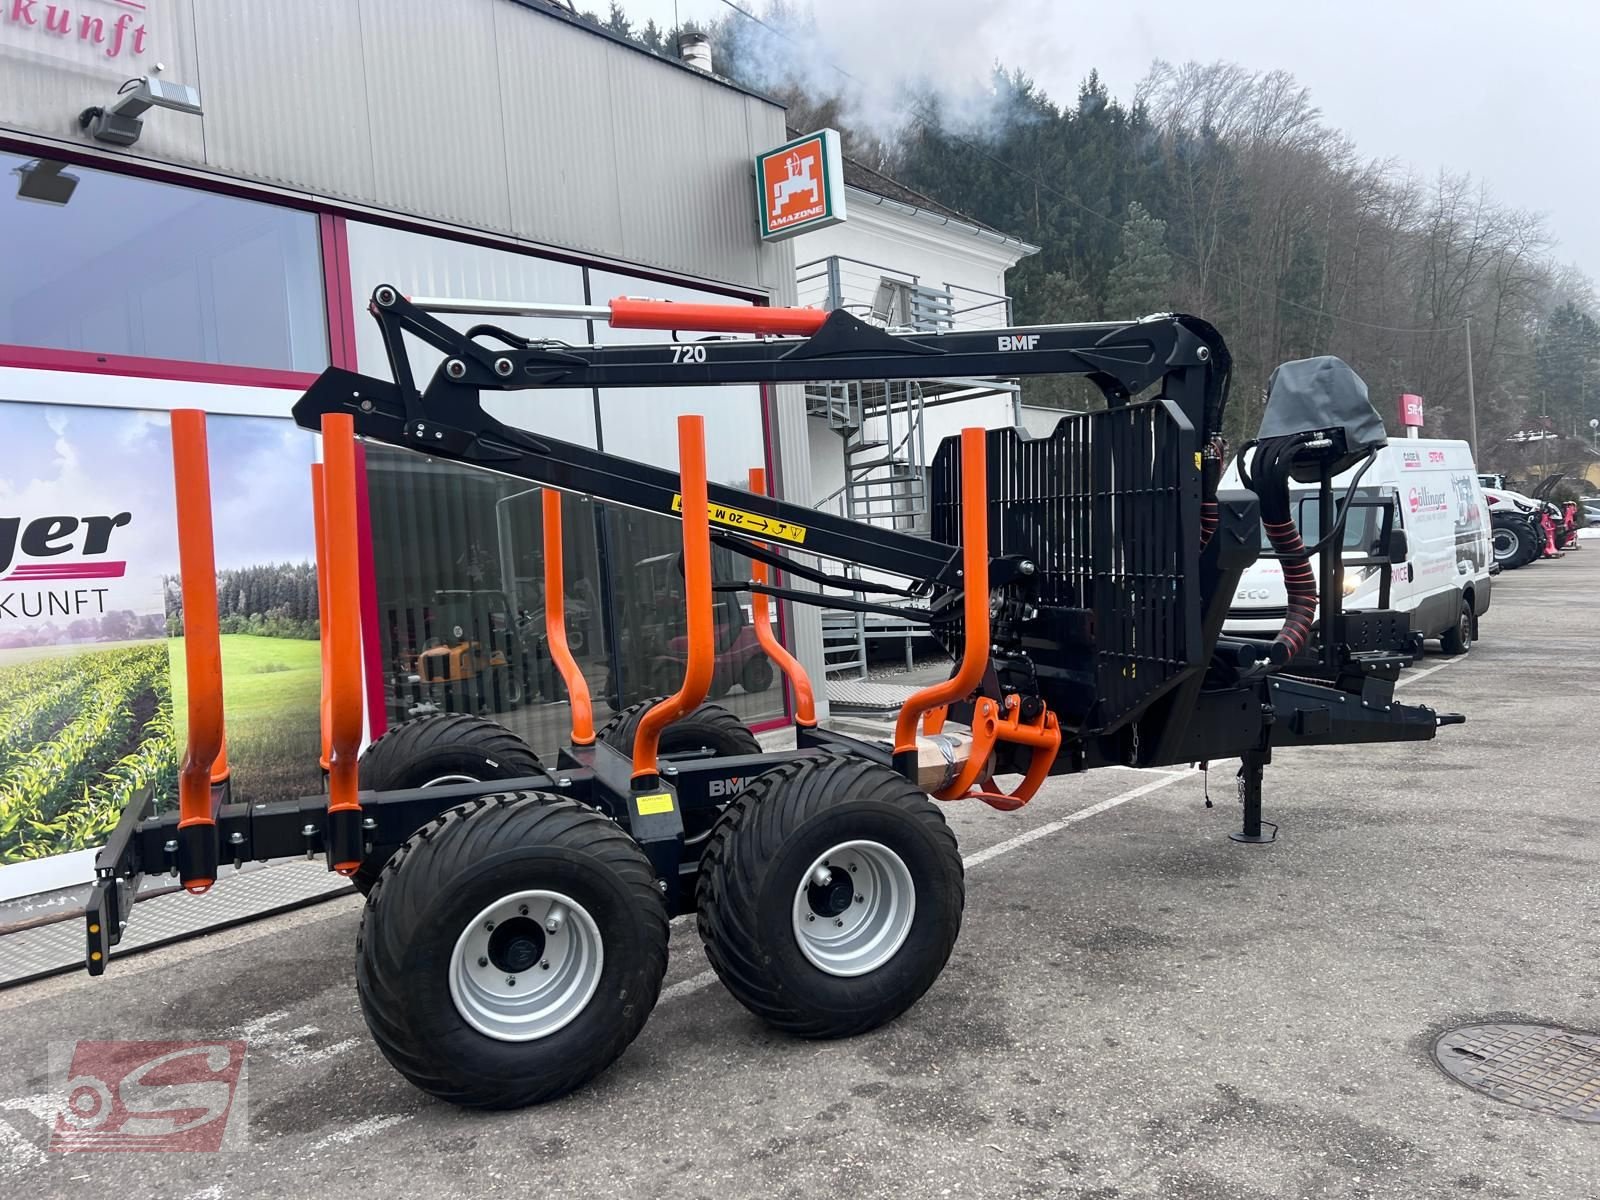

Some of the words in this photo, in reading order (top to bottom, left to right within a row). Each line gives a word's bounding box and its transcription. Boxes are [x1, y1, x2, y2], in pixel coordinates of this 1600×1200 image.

[0, 0, 147, 57] kunft
[770, 205, 823, 227] AMAZONE
[998, 335, 1040, 351] BMF
[670, 346, 706, 363] 720
[715, 508, 726, 519] M
[729, 512, 744, 524] 20
[0, 588, 109, 619] KUNFT
